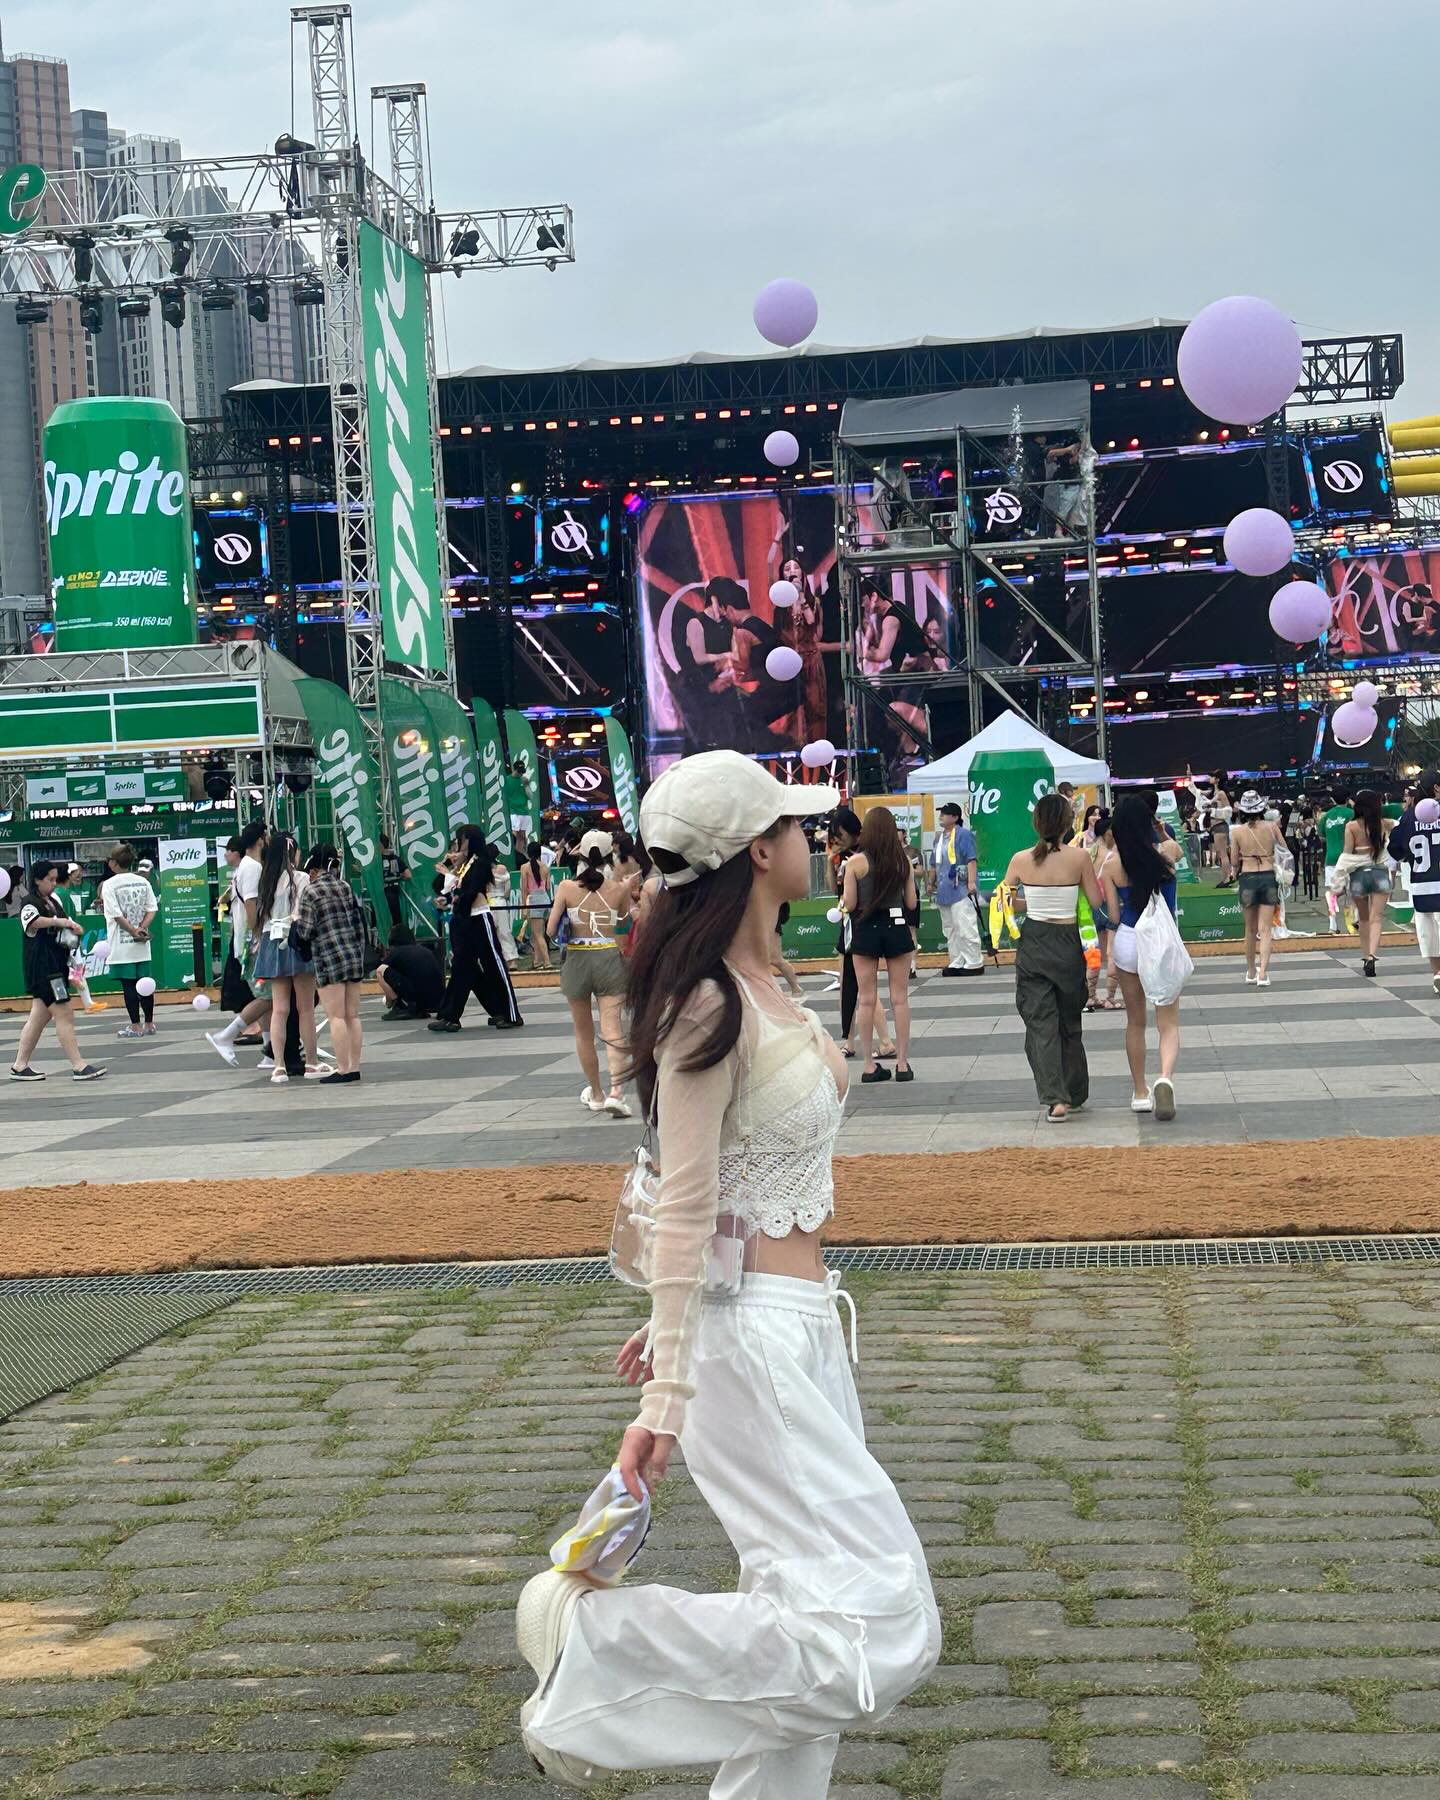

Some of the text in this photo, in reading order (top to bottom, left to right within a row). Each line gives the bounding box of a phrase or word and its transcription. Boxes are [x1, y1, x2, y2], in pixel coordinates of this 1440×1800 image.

[374, 233, 432, 670] Sprite
[44, 451, 184, 536] Sprite
[100, 567, 169, 587] 스프라이트
[134, 820, 164, 833] Sprite
[166, 847, 201, 864] Sprite
